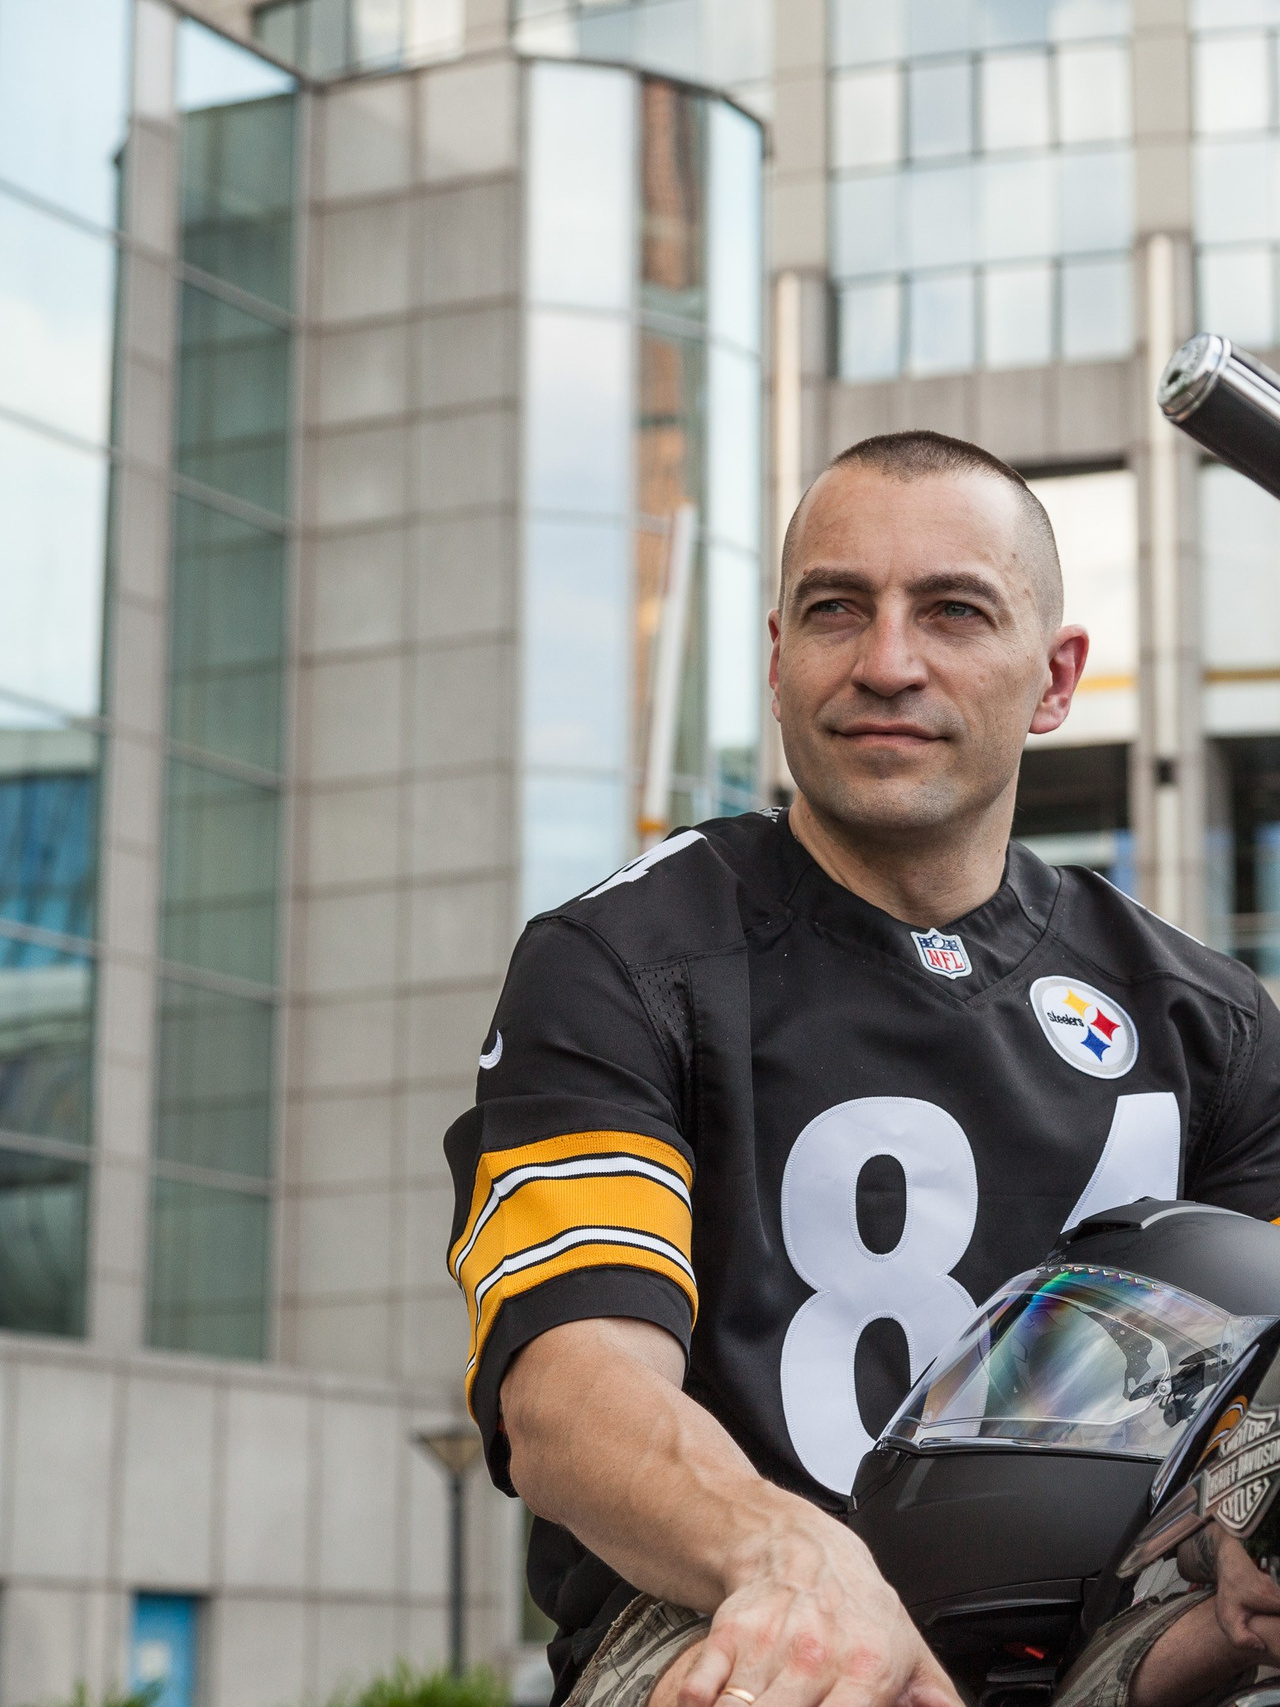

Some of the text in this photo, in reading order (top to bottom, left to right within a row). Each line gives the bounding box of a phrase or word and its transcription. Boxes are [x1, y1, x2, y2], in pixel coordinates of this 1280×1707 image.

[927, 949, 964, 970] NFL
[1047, 1011, 1084, 1028] Steelers
[1222, 1482, 1263, 1522] CYCLES
